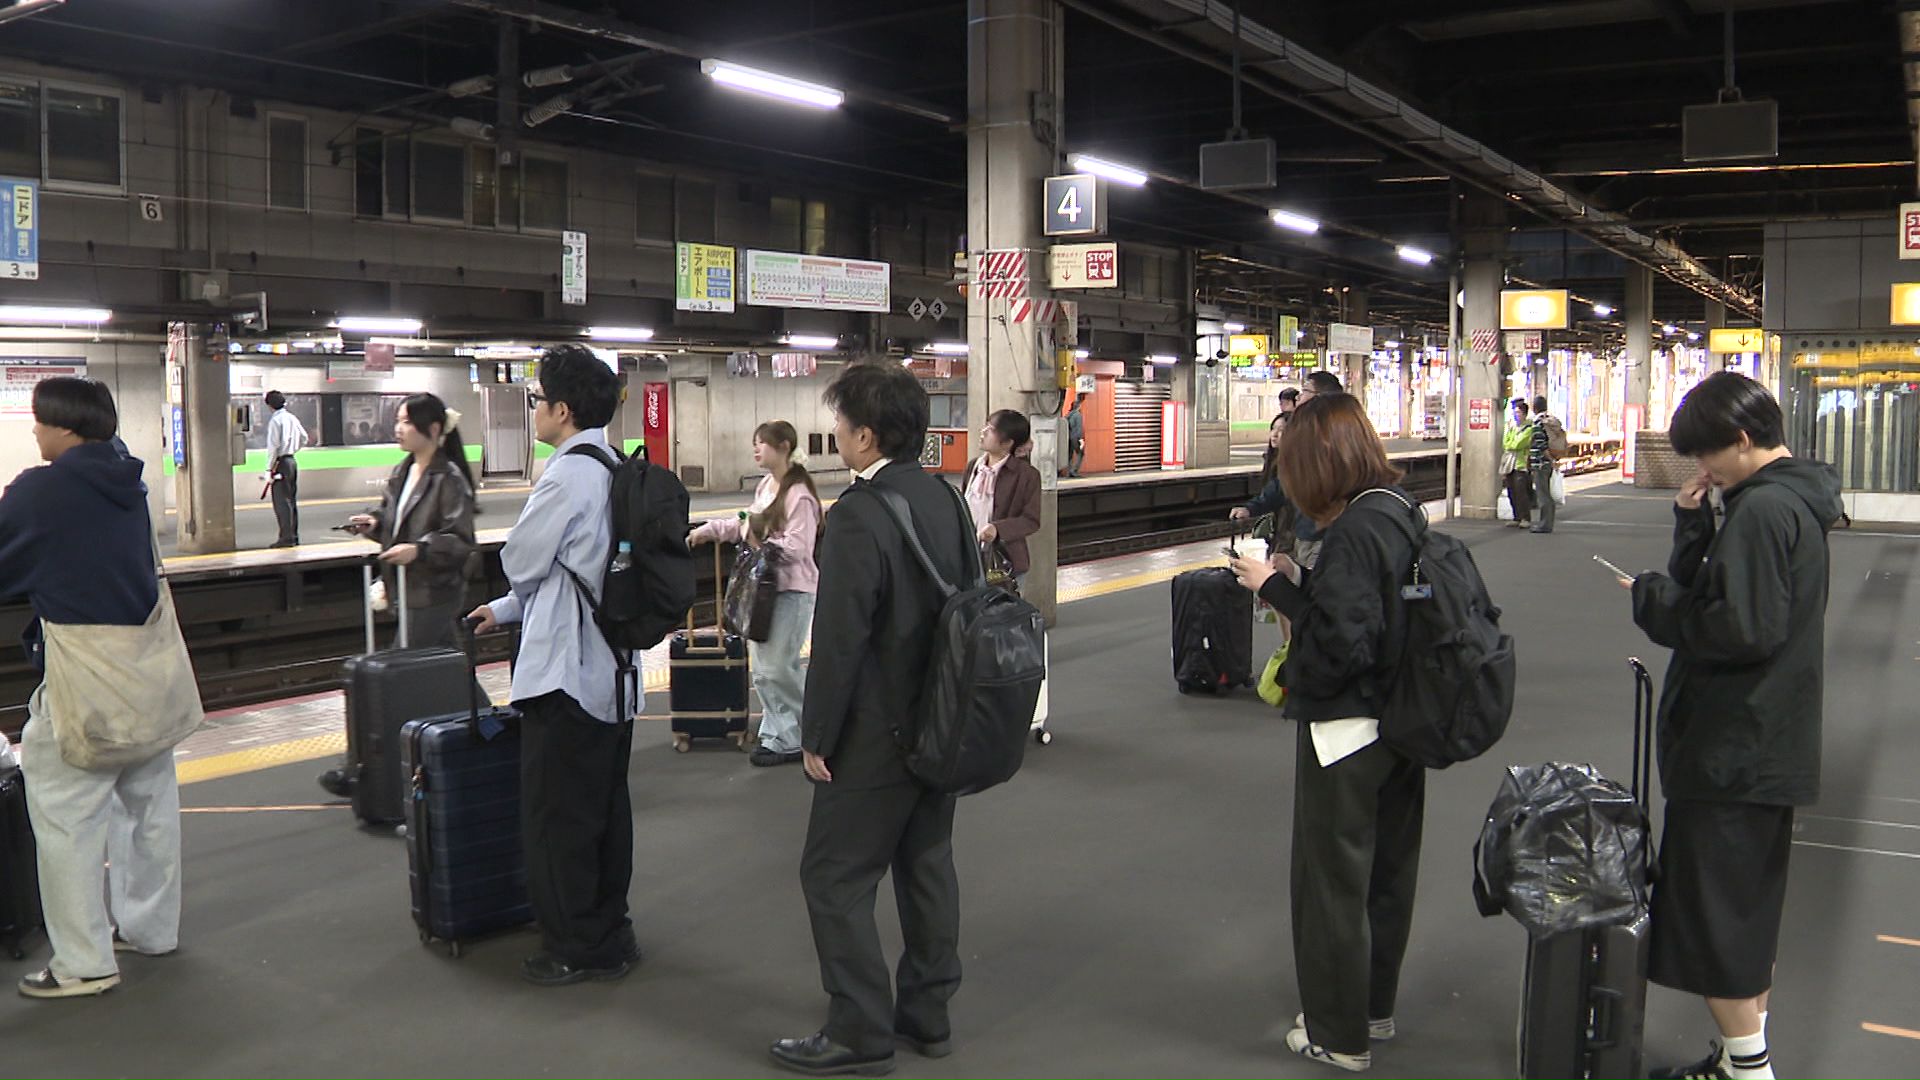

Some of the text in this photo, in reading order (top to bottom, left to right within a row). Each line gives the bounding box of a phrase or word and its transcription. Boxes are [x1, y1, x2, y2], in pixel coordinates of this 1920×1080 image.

[145, 202, 158, 220] 6
[1057, 186, 1082, 223] 4
[1087, 252, 1113, 263] STOP
[10, 263, 20, 277] 3
[694, 247, 703, 297] エアポート
[706, 300, 713, 311] 3
[913, 302, 942, 316] 2 3
